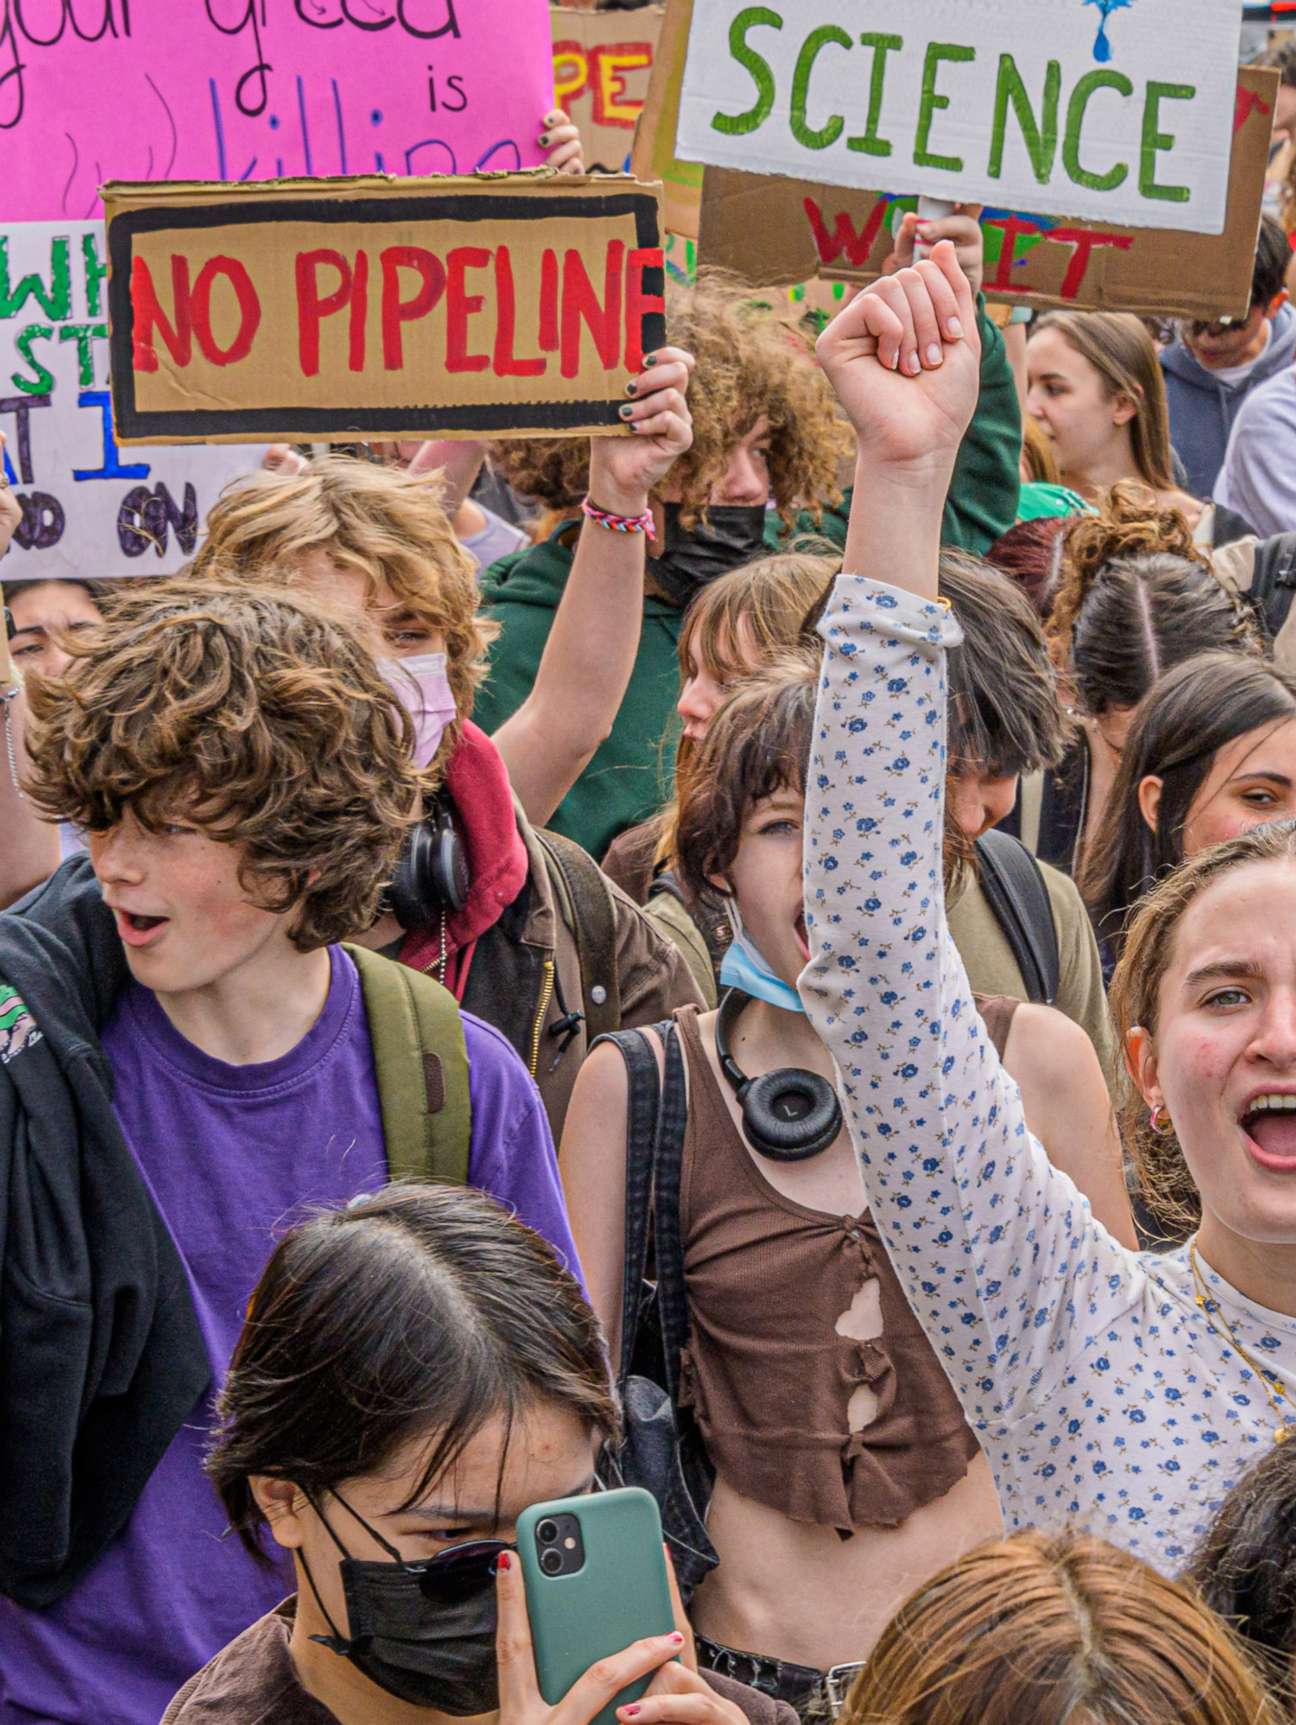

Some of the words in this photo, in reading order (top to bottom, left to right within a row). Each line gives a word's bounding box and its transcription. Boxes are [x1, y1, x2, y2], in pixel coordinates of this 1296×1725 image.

[427, 64, 468, 112] is
[710, 6, 1196, 202] SCIENCE
[130, 254, 262, 373] NO
[295, 239, 666, 378] PIPELINE
[10, 323, 112, 396] ST
[116, 480, 199, 558] ON
